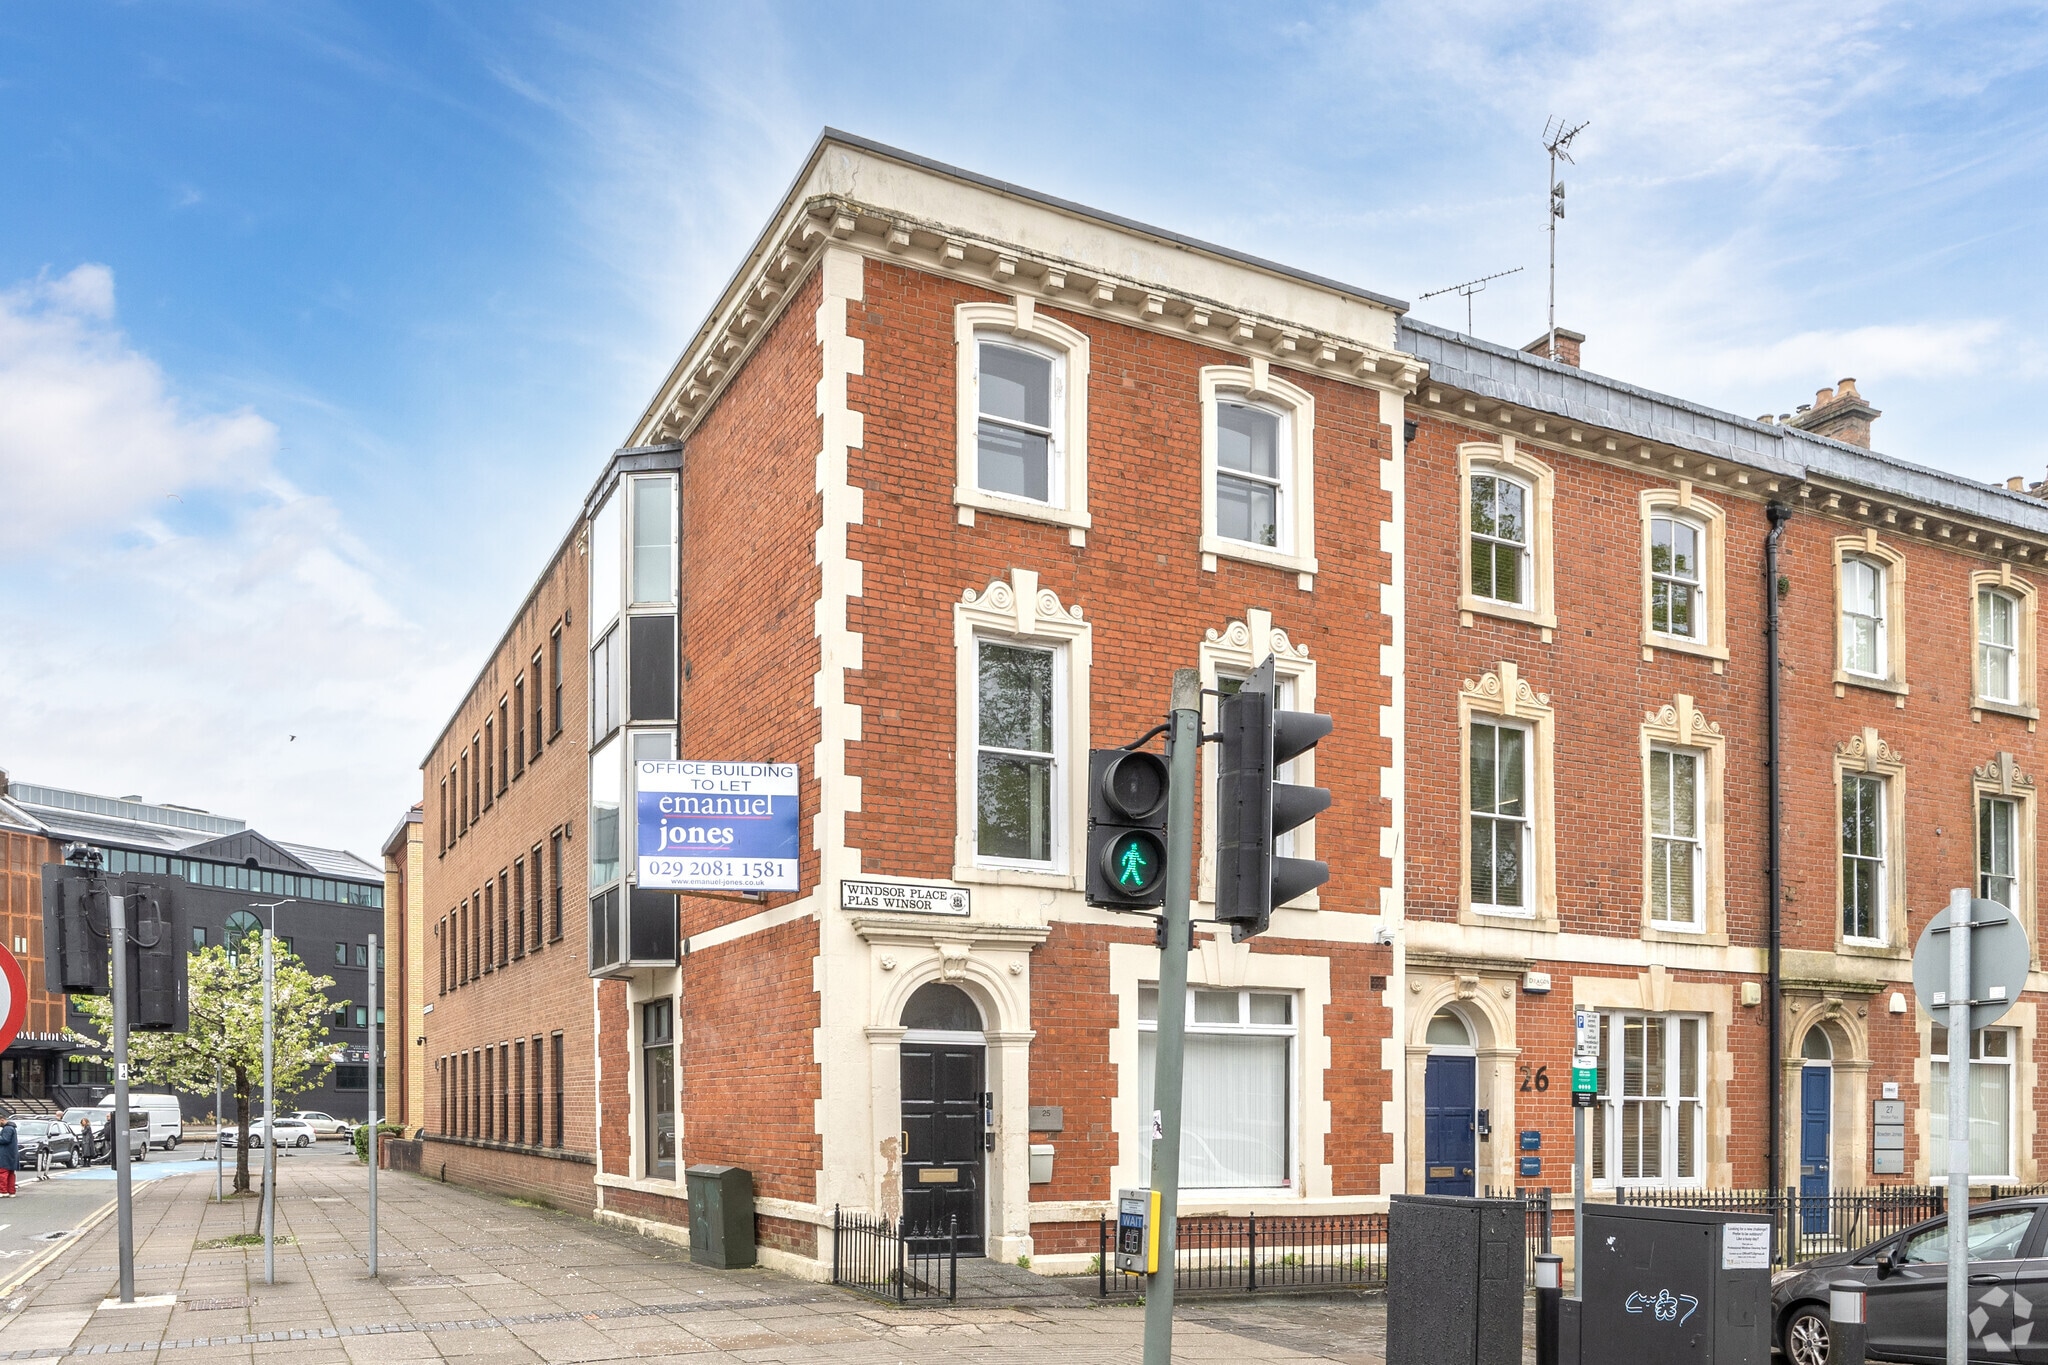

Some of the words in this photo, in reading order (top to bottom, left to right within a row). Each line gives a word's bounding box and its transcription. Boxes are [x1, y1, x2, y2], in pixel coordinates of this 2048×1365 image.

[642, 762, 706, 775] OFFICE
[712, 764, 793, 778] BUILDING
[691, 779, 714, 790] TO
[720, 780, 751, 791] LET
[659, 795, 774, 815] emanuel
[657, 818, 734, 851] jones
[649, 861, 683, 877] 029
[690, 860, 733, 876] 2081
[742, 861, 784, 879] 1581
[671, 879, 764, 887] www.emanuel-jones.co.uk
[847, 884, 905, 897] WINDSOR
[910, 889, 948, 900] PLACE
[847, 895, 879, 906] PLAS
[883, 898, 932, 910] WINSOR
[16, 1031, 37, 1040] OAL
[1519, 1065, 1549, 1092] 26
[1042, 1109, 1051, 1117] 25
[1886, 1106, 1894, 1114] 27
[1122, 1214, 1143, 1228] WAIT
